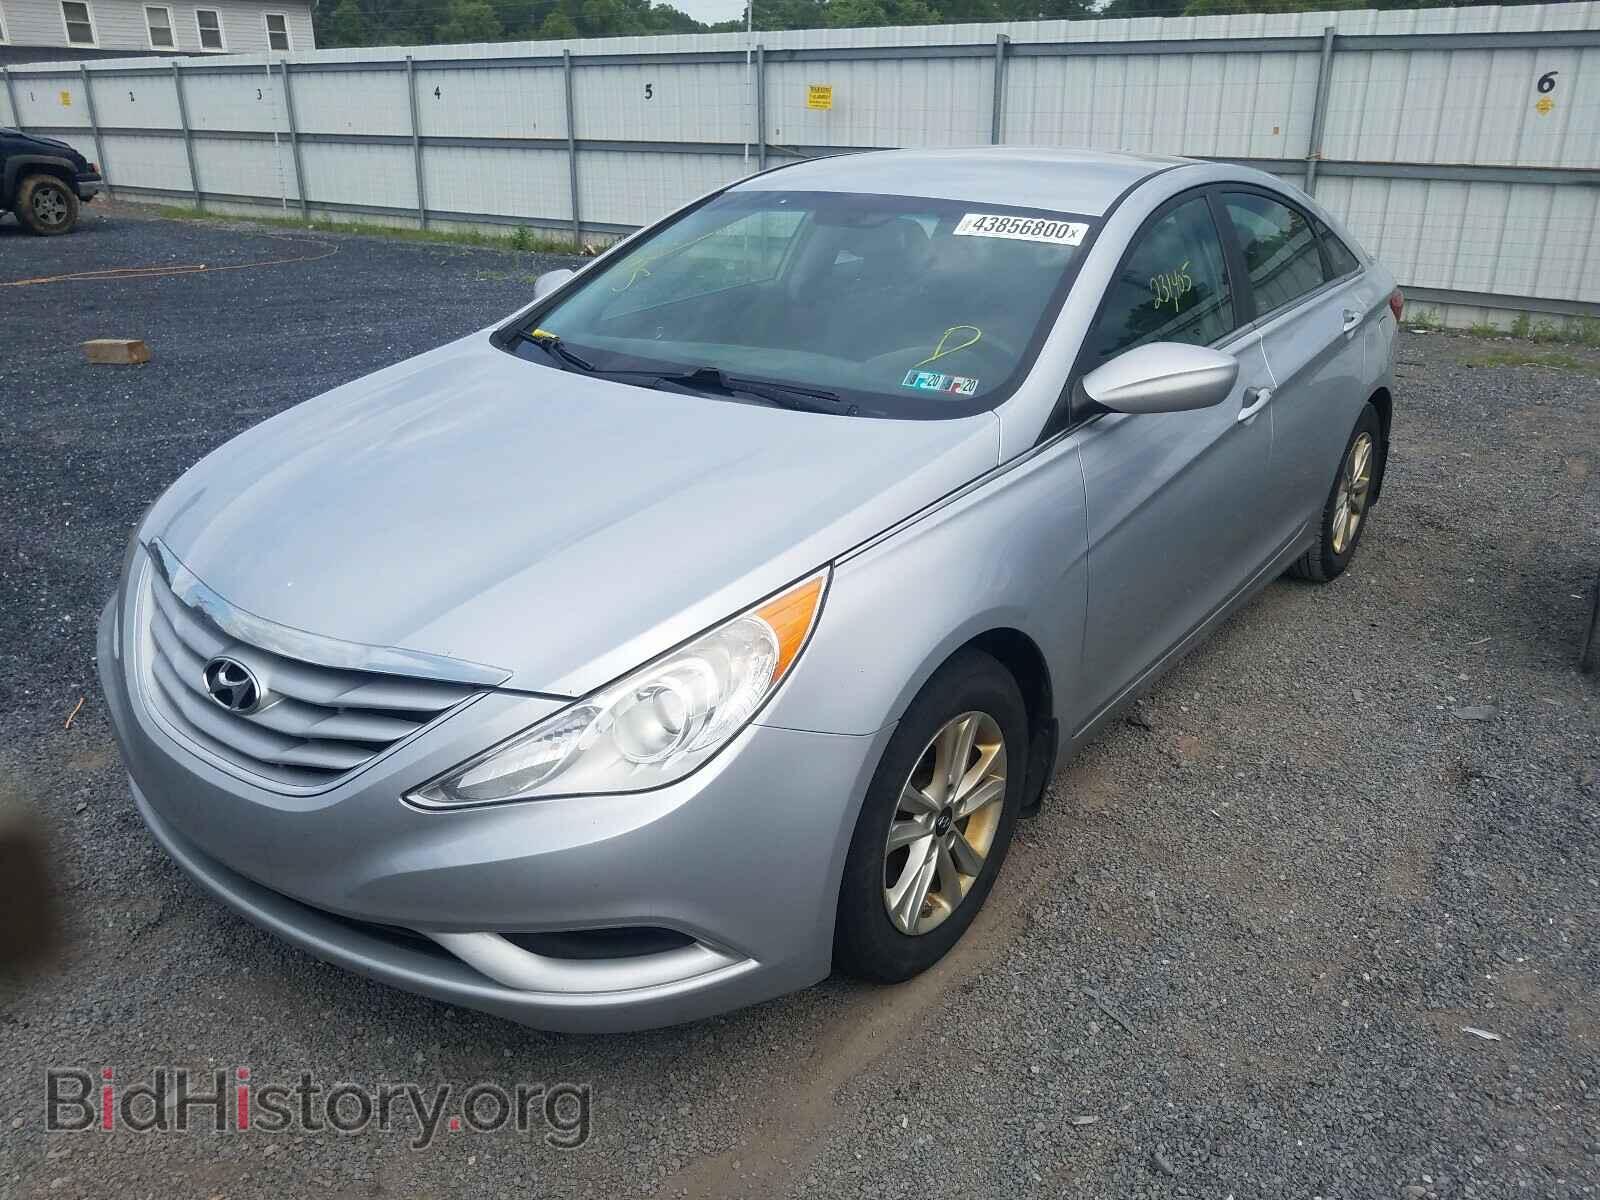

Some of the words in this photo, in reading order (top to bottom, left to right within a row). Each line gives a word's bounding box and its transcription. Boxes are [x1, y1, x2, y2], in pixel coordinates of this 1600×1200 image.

[1537, 71, 1559, 94] 6
[256, 88, 263, 100] 3
[434, 85, 442, 100] 4
[644, 83, 653, 100] 5
[927, 374, 941, 387] 20
[963, 379, 977, 393] 20
